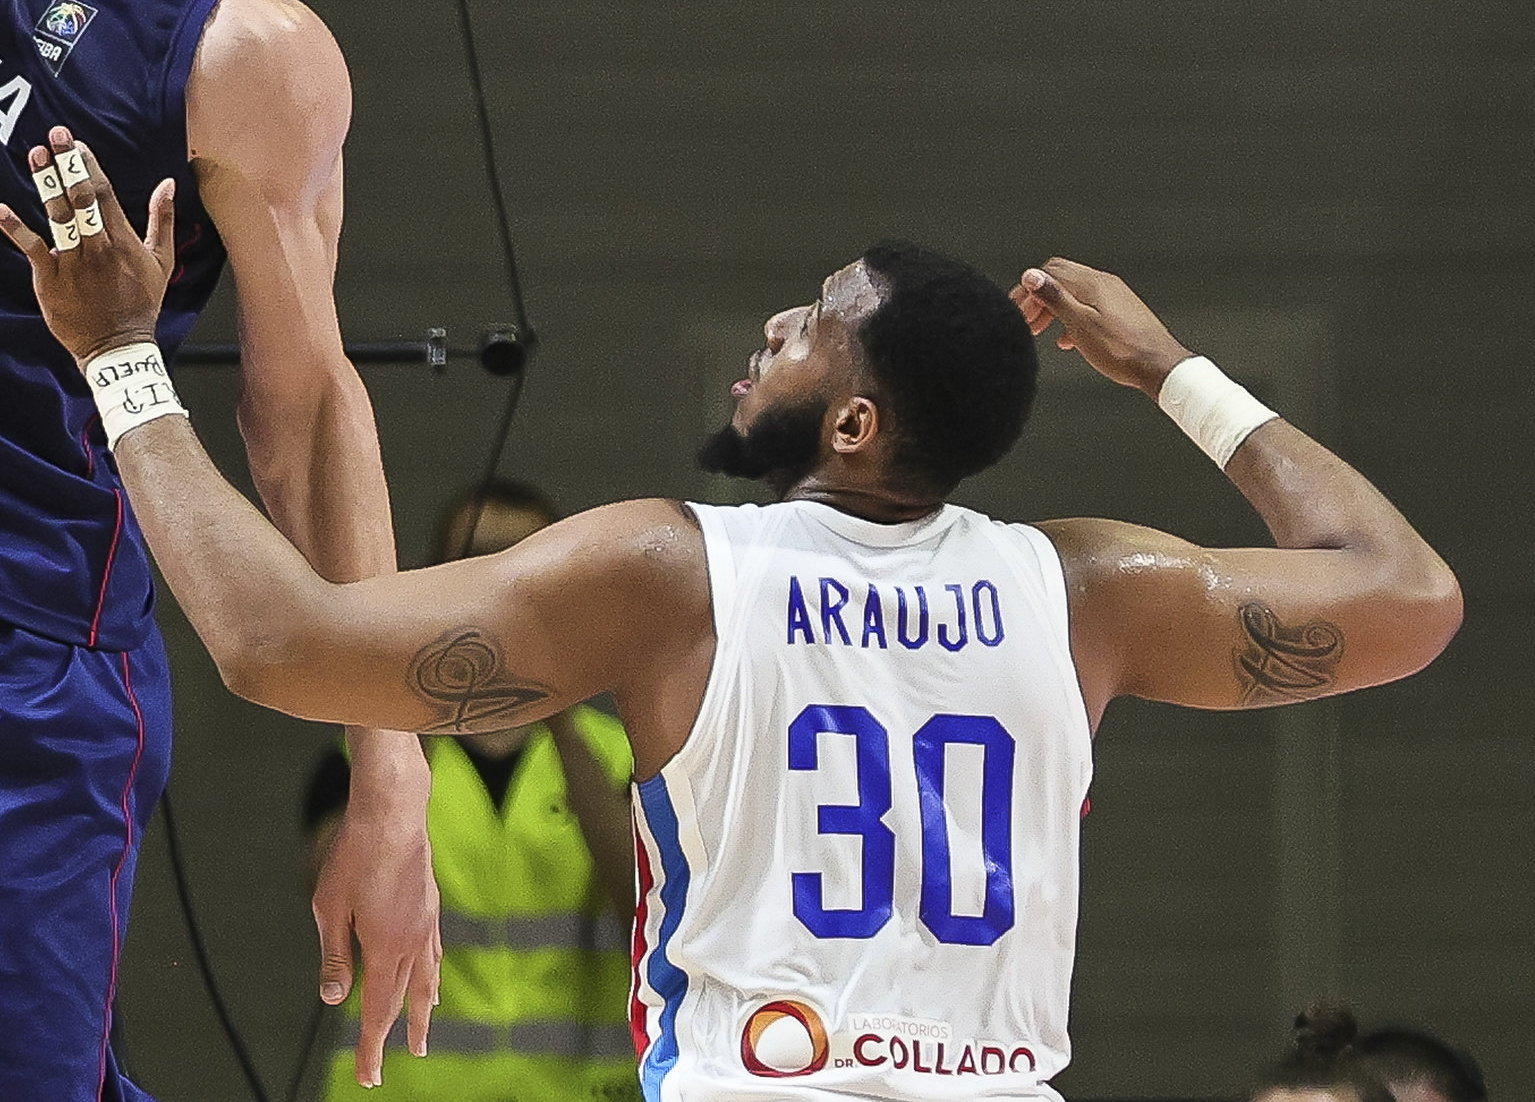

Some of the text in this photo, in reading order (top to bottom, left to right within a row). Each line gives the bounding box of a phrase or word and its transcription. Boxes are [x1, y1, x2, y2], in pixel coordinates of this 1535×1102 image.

[787, 576, 1005, 652] ARAUJO
[787, 704, 1016, 946] 30
[834, 1033, 1036, 1076] DR COLLADO
[853, 1017, 949, 1039] LABOATORIOS
